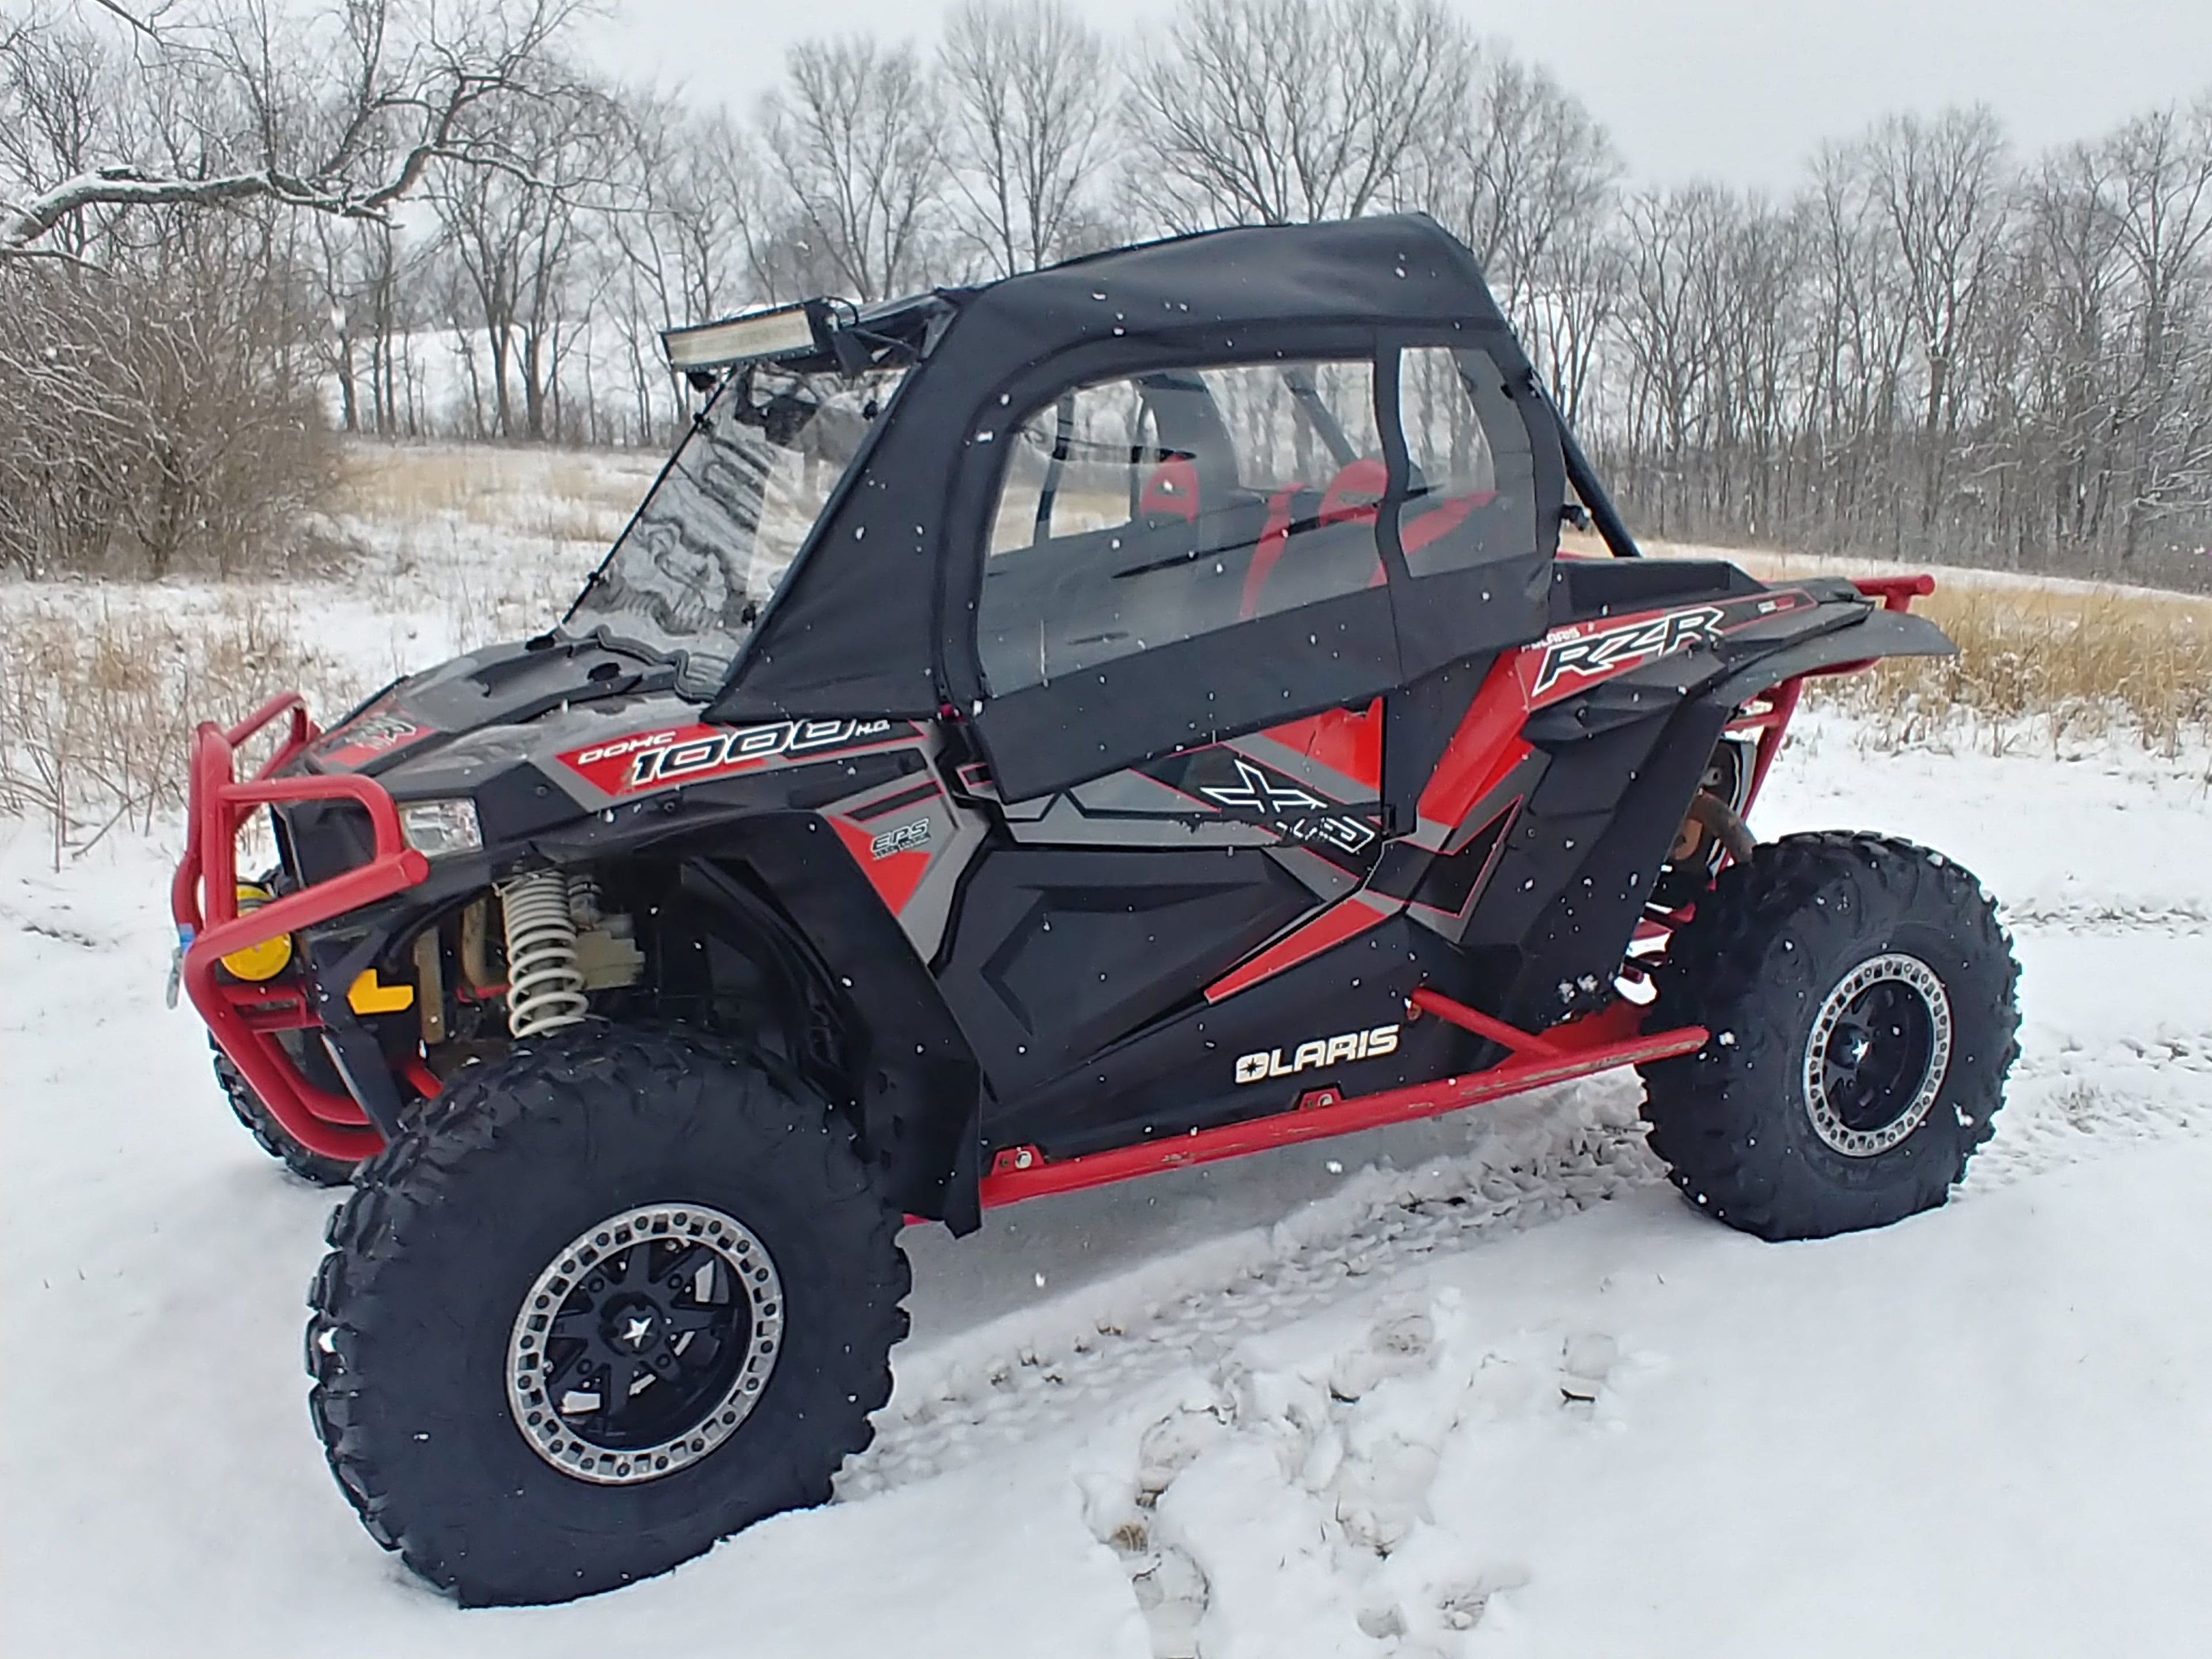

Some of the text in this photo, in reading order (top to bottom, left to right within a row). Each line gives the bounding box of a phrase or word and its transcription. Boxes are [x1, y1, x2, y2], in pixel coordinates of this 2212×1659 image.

[1531, 607, 1725, 698] RZR
[577, 732, 676, 765] DOHC
[631, 719, 857, 786] 1000
[870, 817, 930, 853] EPS
